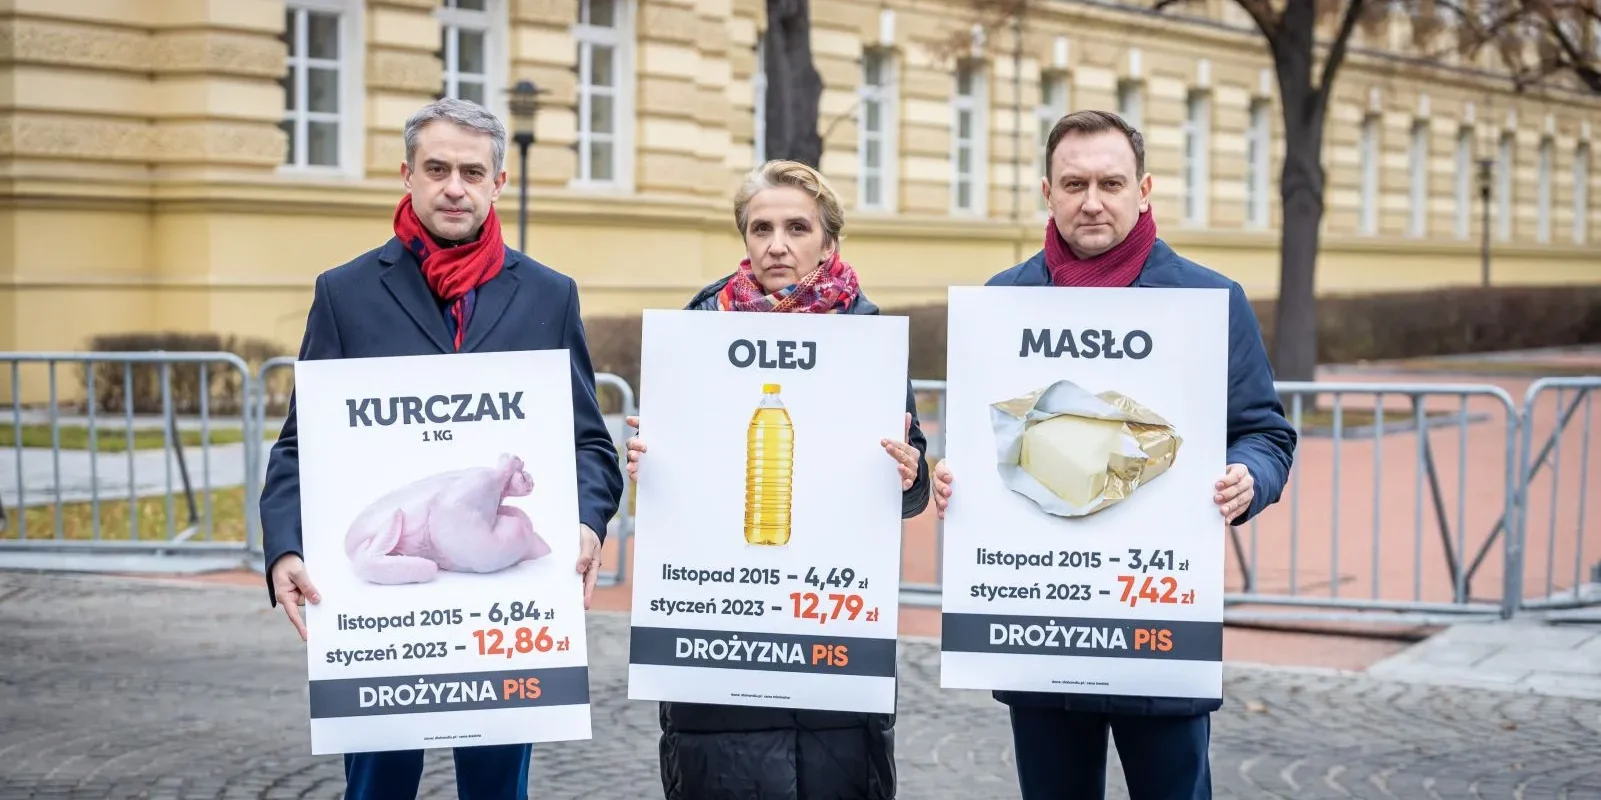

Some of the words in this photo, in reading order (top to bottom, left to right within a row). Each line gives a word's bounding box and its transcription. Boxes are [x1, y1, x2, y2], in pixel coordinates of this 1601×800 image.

[728, 339, 816, 370] OLEJ
[1020, 329, 1152, 359] MASŁO
[346, 391, 525, 427] KURCZAK
[422, 430, 431, 442] 1
[432, 429, 453, 442] KG
[976, 547, 1054, 571] listopad
[1058, 550, 1102, 569] 2015
[1127, 548, 1174, 574] 3,41
[1178, 559, 1190, 571] zł
[662, 563, 735, 586] listopad
[739, 567, 781, 586] 2015
[804, 566, 856, 591] 4,49
[858, 577, 869, 590] zł
[969, 582, 1041, 602] styczeń
[1045, 583, 1092, 601] 2023
[1118, 576, 1177, 607] 7,42
[1180, 589, 1196, 605] zł
[337, 610, 415, 633] listopad
[419, 608, 464, 627] 2015
[487, 600, 541, 626] 6,84
[544, 608, 555, 620] zł
[649, 597, 717, 616] styczeń
[720, 598, 765, 617] 2023
[790, 593, 863, 624] 12,79
[865, 606, 879, 622] zł
[325, 643, 398, 667] styczeń
[401, 641, 448, 660] 2023
[473, 627, 553, 658] 12,86
[556, 636, 570, 652] zł
[676, 635, 805, 664] DROŻYZNA
[812, 644, 849, 667] PiS
[990, 620, 1127, 649] DROŻYZNA
[1134, 628, 1173, 652] PiS
[359, 678, 497, 707] DROŻYZNA
[503, 677, 542, 701] PiS
